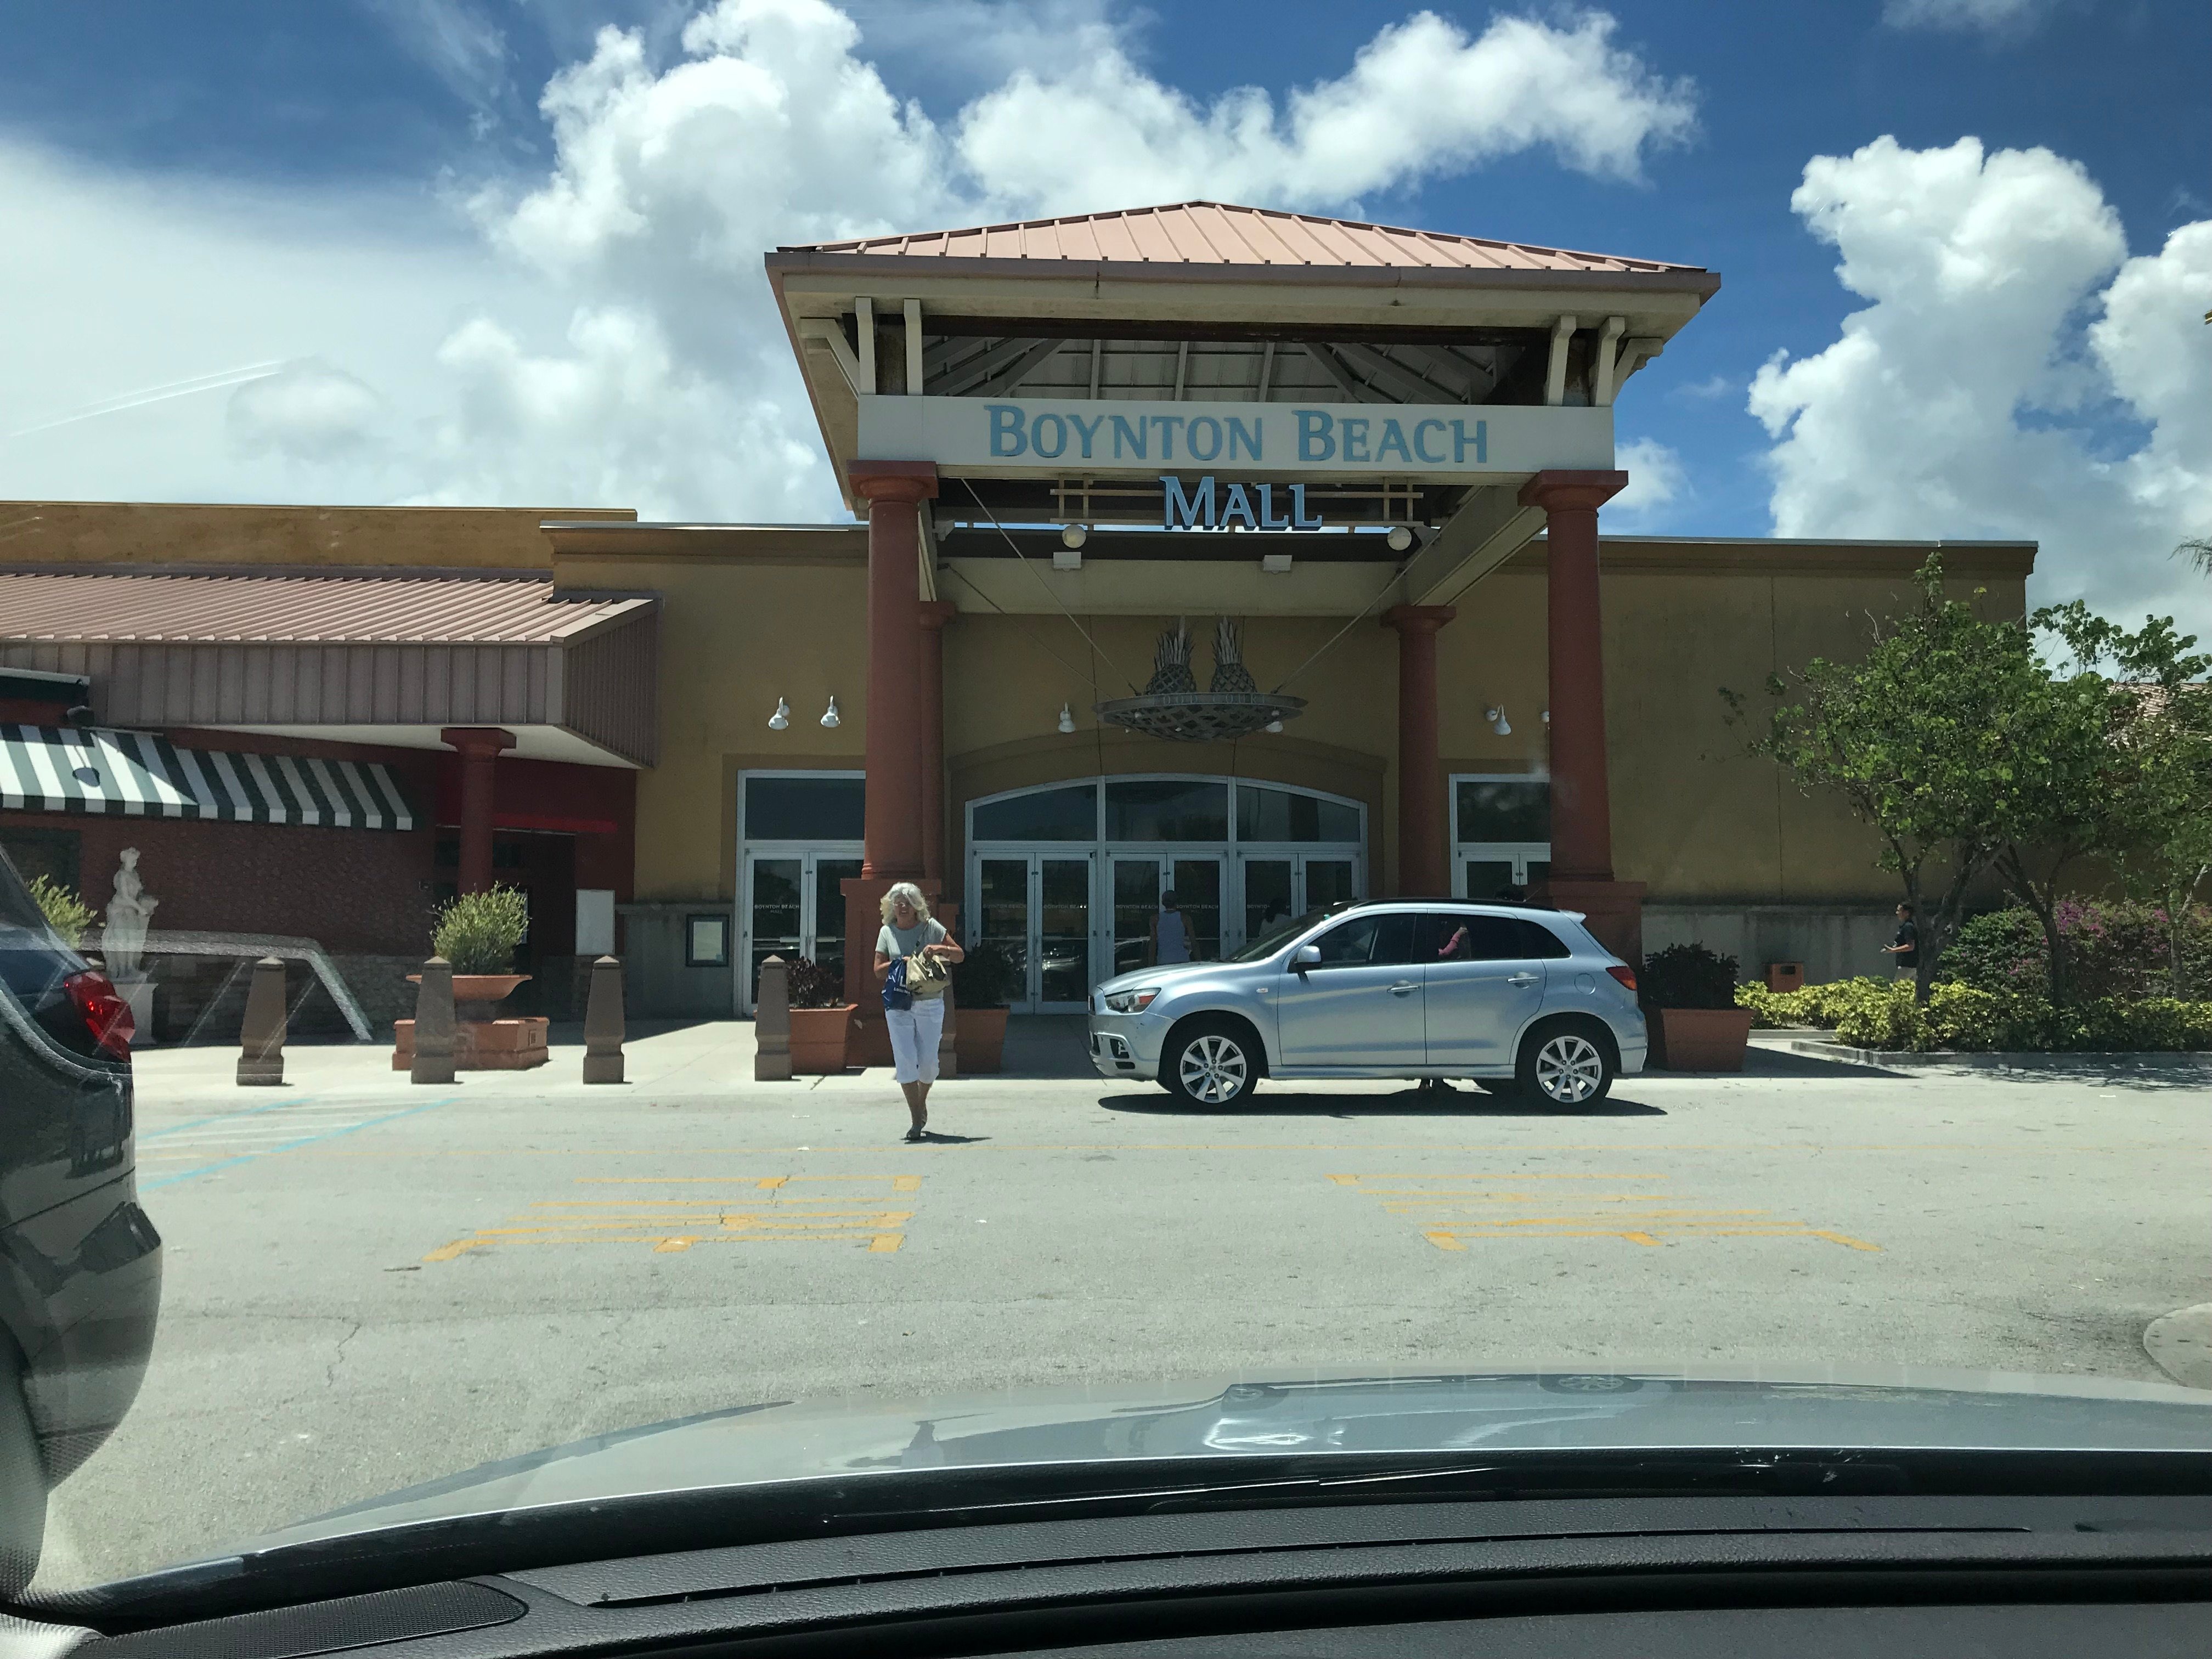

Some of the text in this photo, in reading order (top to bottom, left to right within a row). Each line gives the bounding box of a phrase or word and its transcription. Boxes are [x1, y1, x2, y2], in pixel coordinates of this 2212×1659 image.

[984, 404, 1487, 464] BOYNTON BEACH
[1159, 476, 1323, 529] MALL
